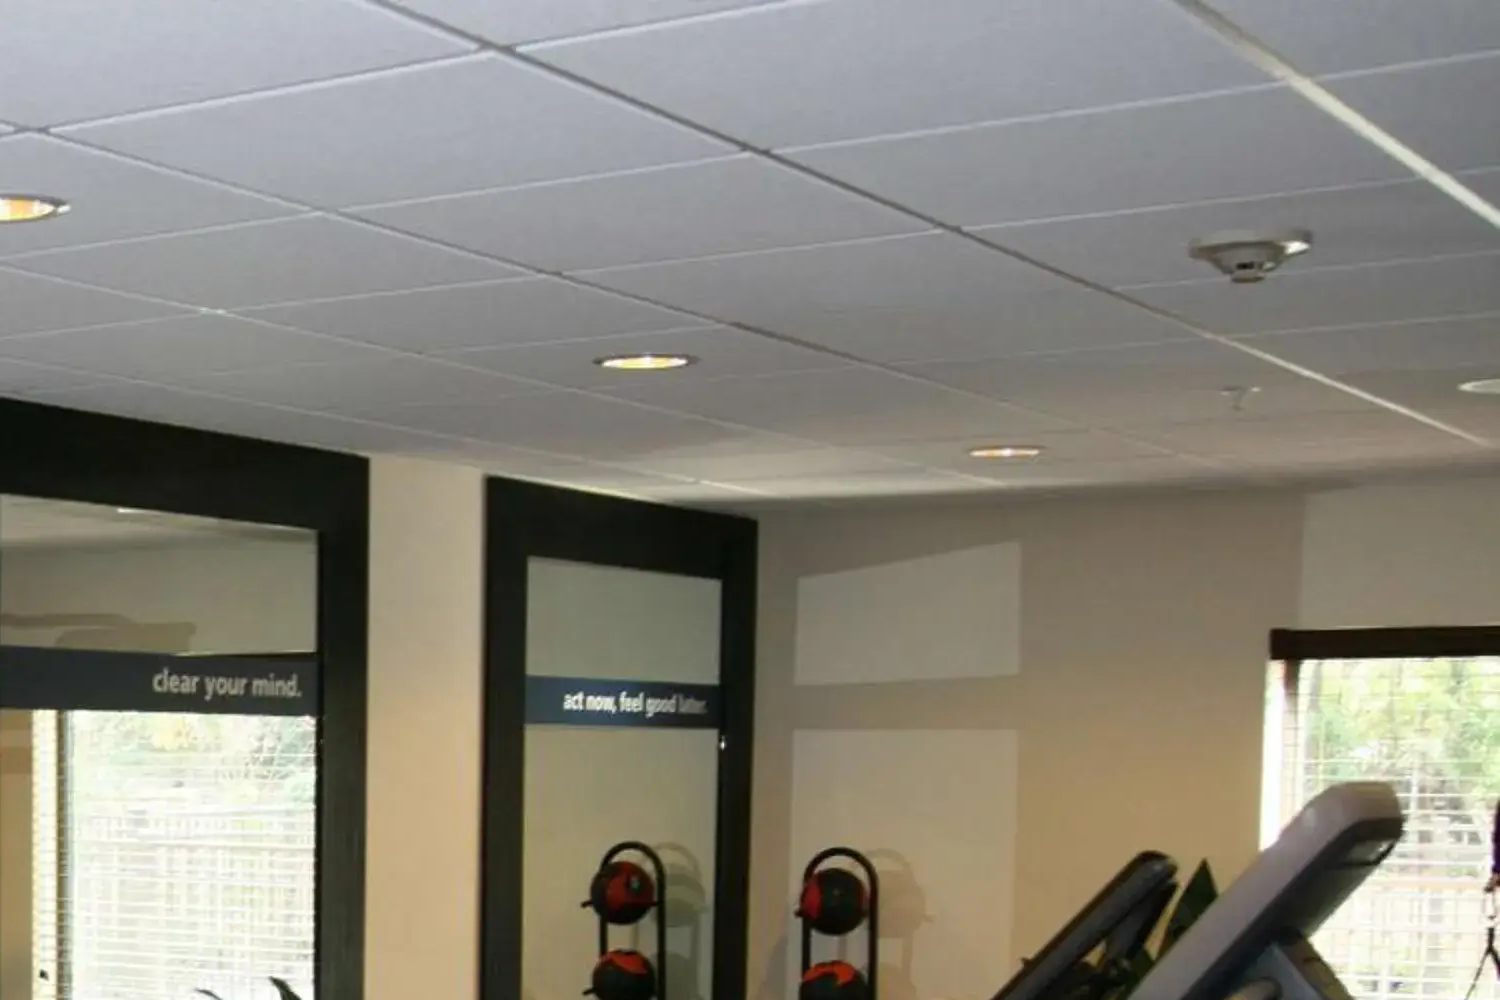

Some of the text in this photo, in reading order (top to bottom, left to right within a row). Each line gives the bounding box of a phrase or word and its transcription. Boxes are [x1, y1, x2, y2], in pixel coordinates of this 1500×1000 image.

[152, 665, 303, 702] clear your mind.
[563, 691, 585, 711] act
[586, 694, 617, 715] now,
[620, 691, 645, 713] feel
[645, 693, 677, 719] good
